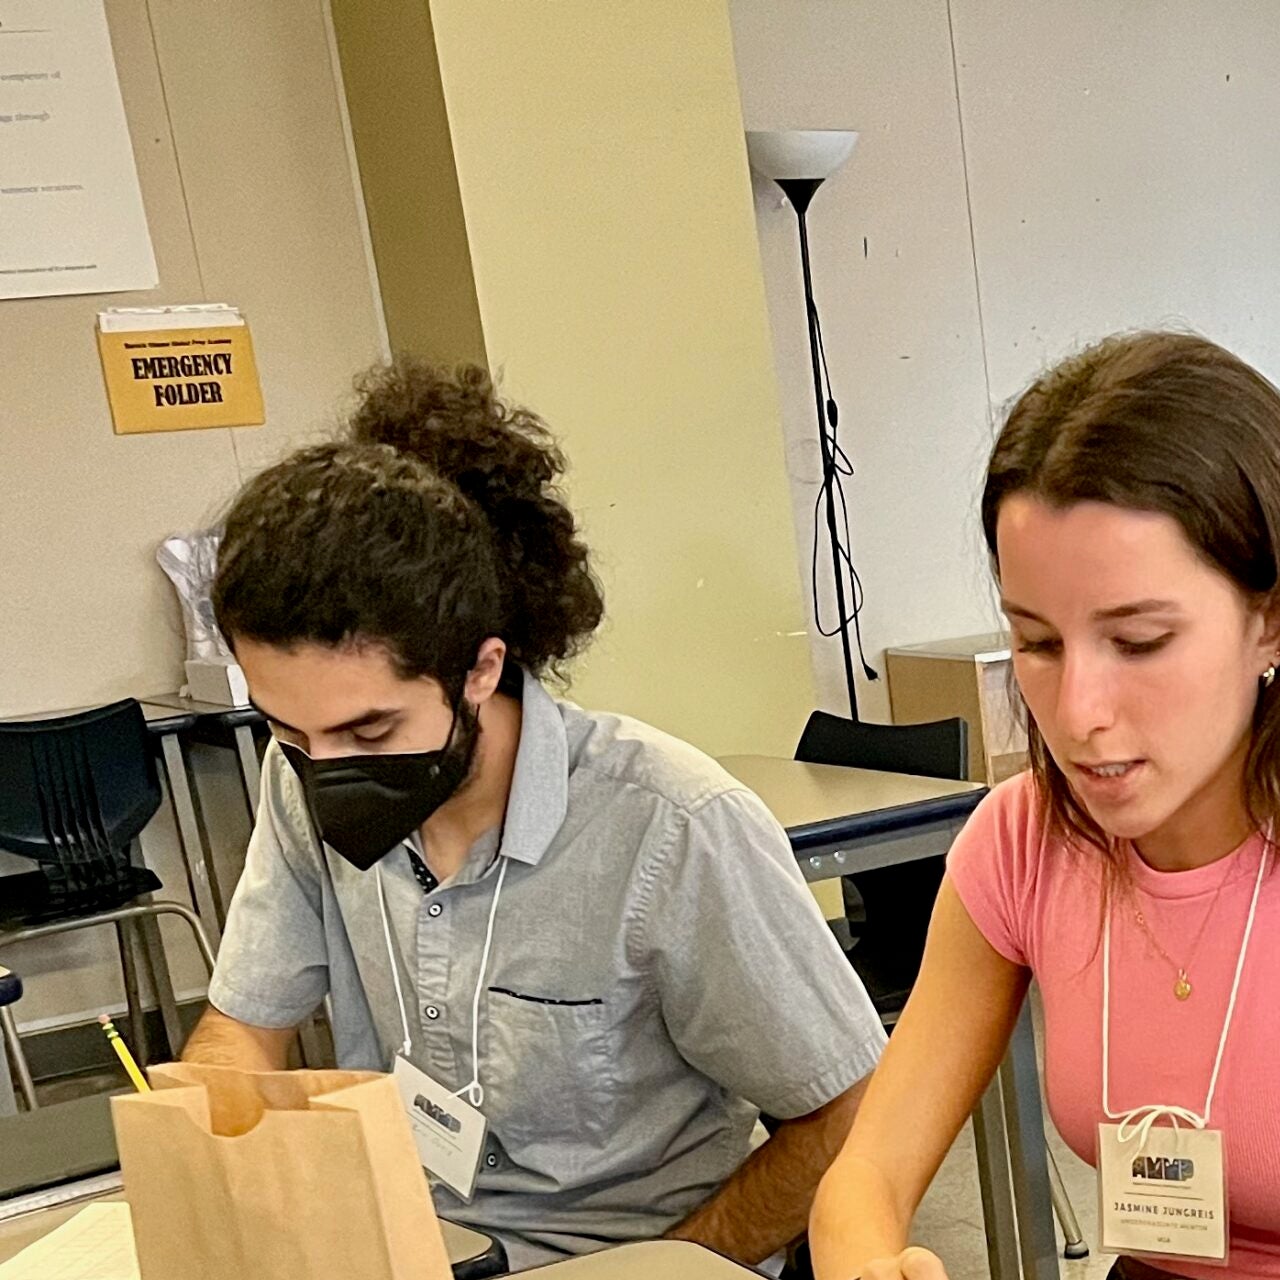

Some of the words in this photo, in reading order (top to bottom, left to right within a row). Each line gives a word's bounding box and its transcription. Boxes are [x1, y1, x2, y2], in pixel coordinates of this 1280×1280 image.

[131, 353, 232, 379] EMERGENCY
[153, 381, 223, 407] FOLDER
[1114, 1202, 1159, 1215] JASMINE
